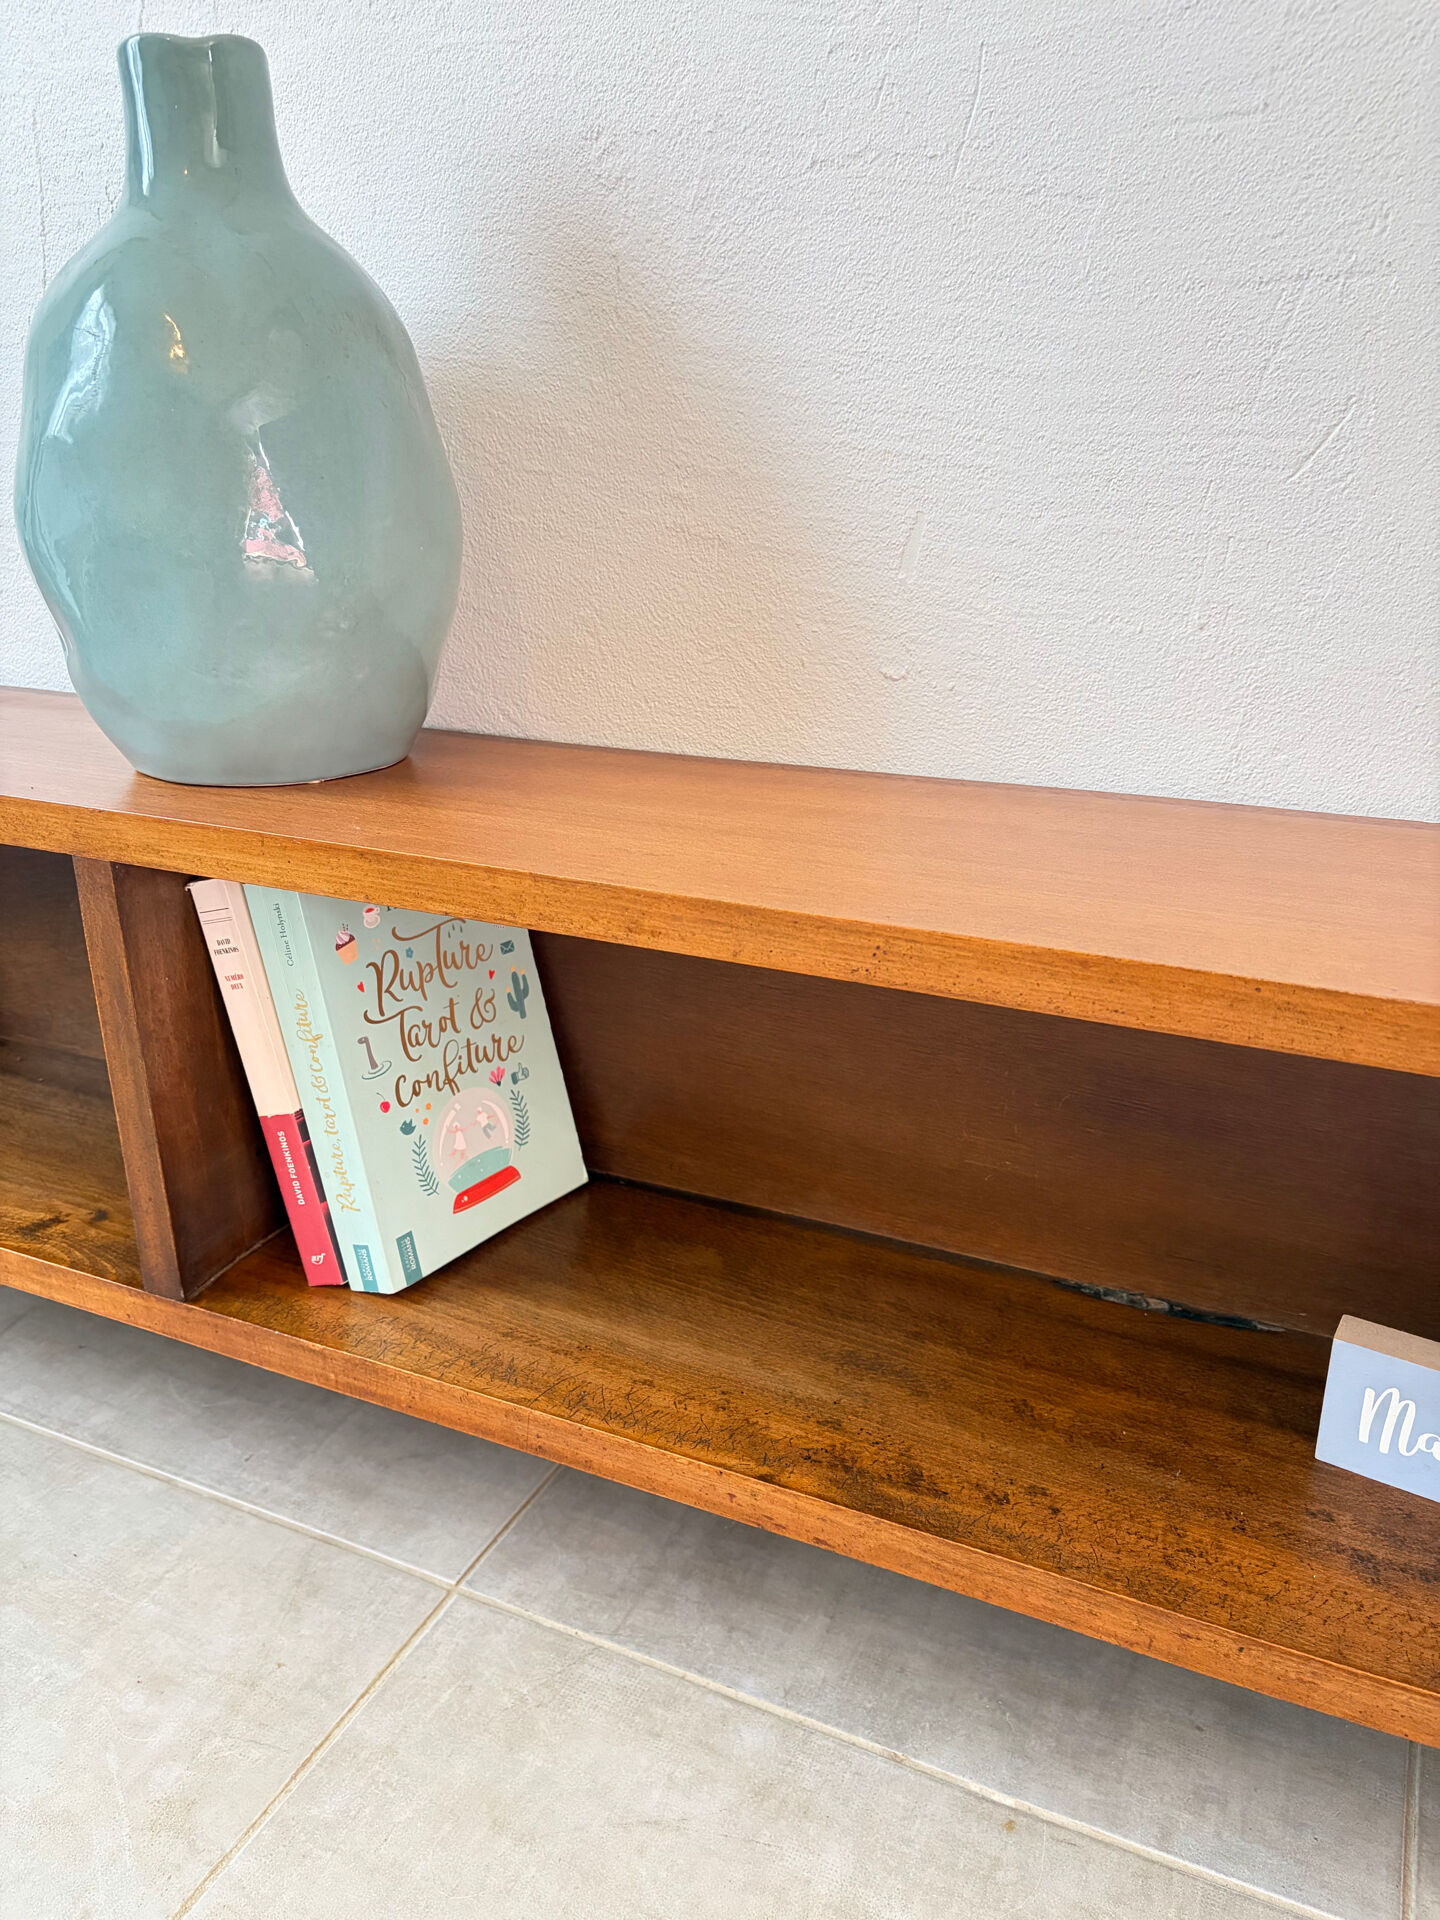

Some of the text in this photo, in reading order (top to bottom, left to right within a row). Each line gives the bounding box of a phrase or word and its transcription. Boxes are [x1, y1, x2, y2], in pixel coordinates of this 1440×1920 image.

[213, 946, 240, 957] FOENKINOS
[216, 938, 231, 947] DAVID
[273, 903, 294, 967] Céline Holynski
[366, 917, 493, 1017] Rupture
[364, 987, 496, 1062] Tarot &
[312, 1075, 328, 1094] &
[316, 1097, 339, 1135] tarot
[277, 1131, 305, 1205] DAVID FOENKINOS
[362, 1248, 373, 1281] ROMANS
[405, 1236, 416, 1270] ROMANS
